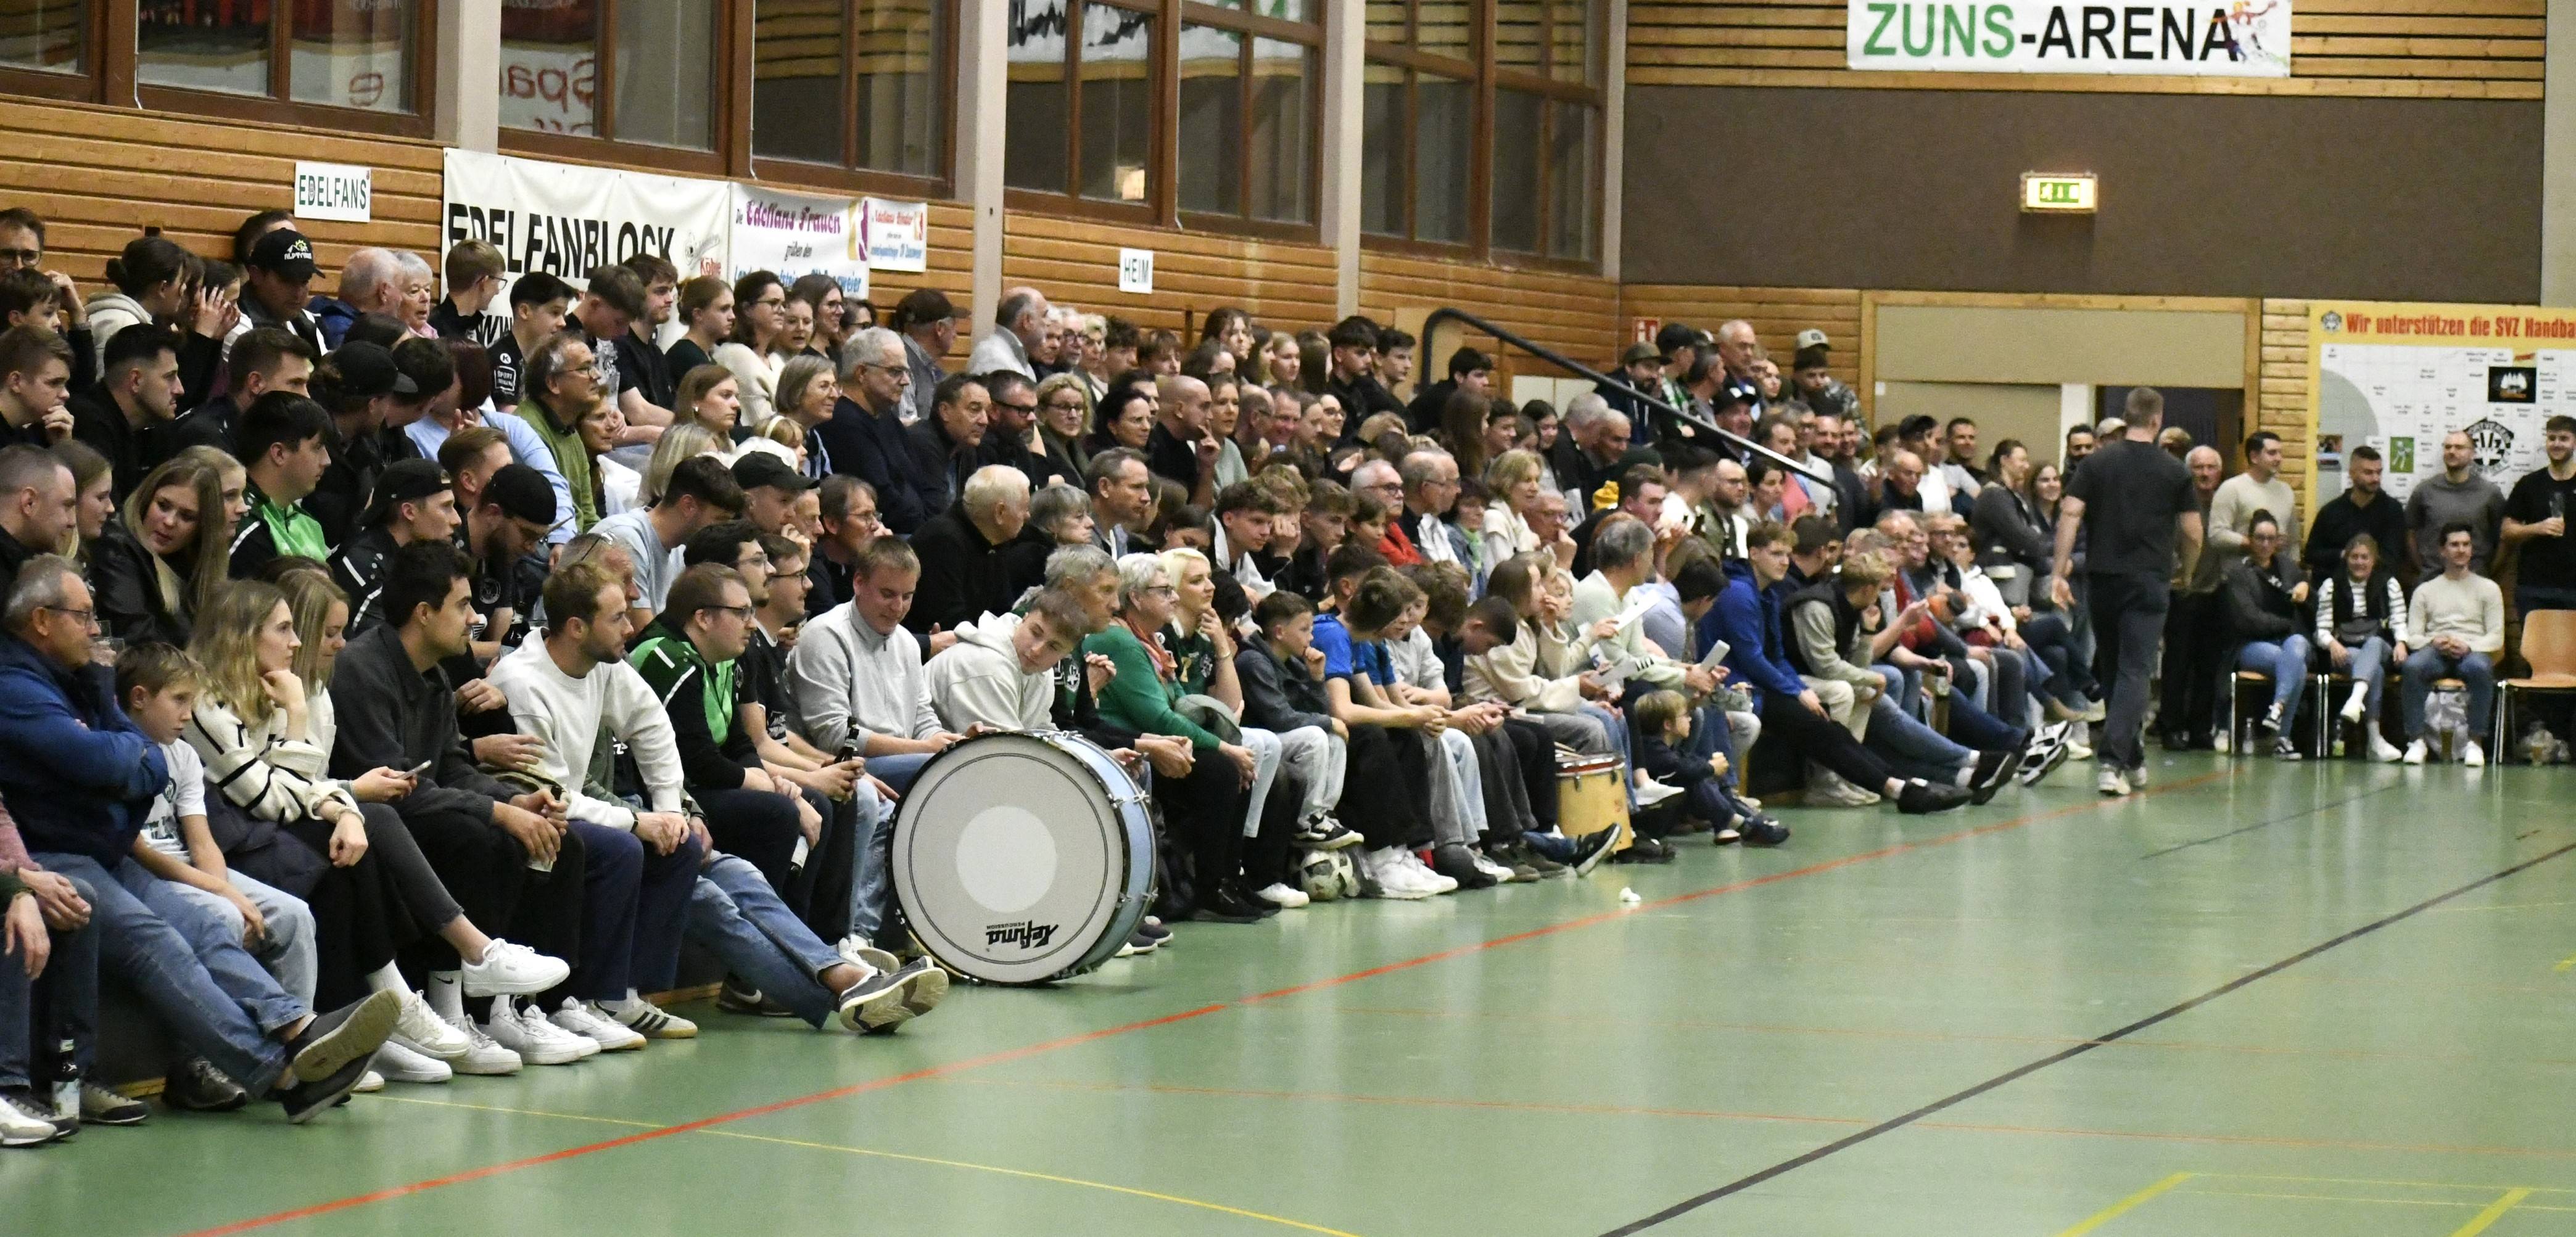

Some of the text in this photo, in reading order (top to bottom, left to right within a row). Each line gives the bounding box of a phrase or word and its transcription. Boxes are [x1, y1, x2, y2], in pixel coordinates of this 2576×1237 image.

[1863, 3, 2238, 61] ZUNS-ARENA
[299, 175, 367, 210] EDELFANS
[1125, 258, 1149, 283] HEIM
[2347, 313, 2576, 338] Wir unterstützen die SVZ Handba
